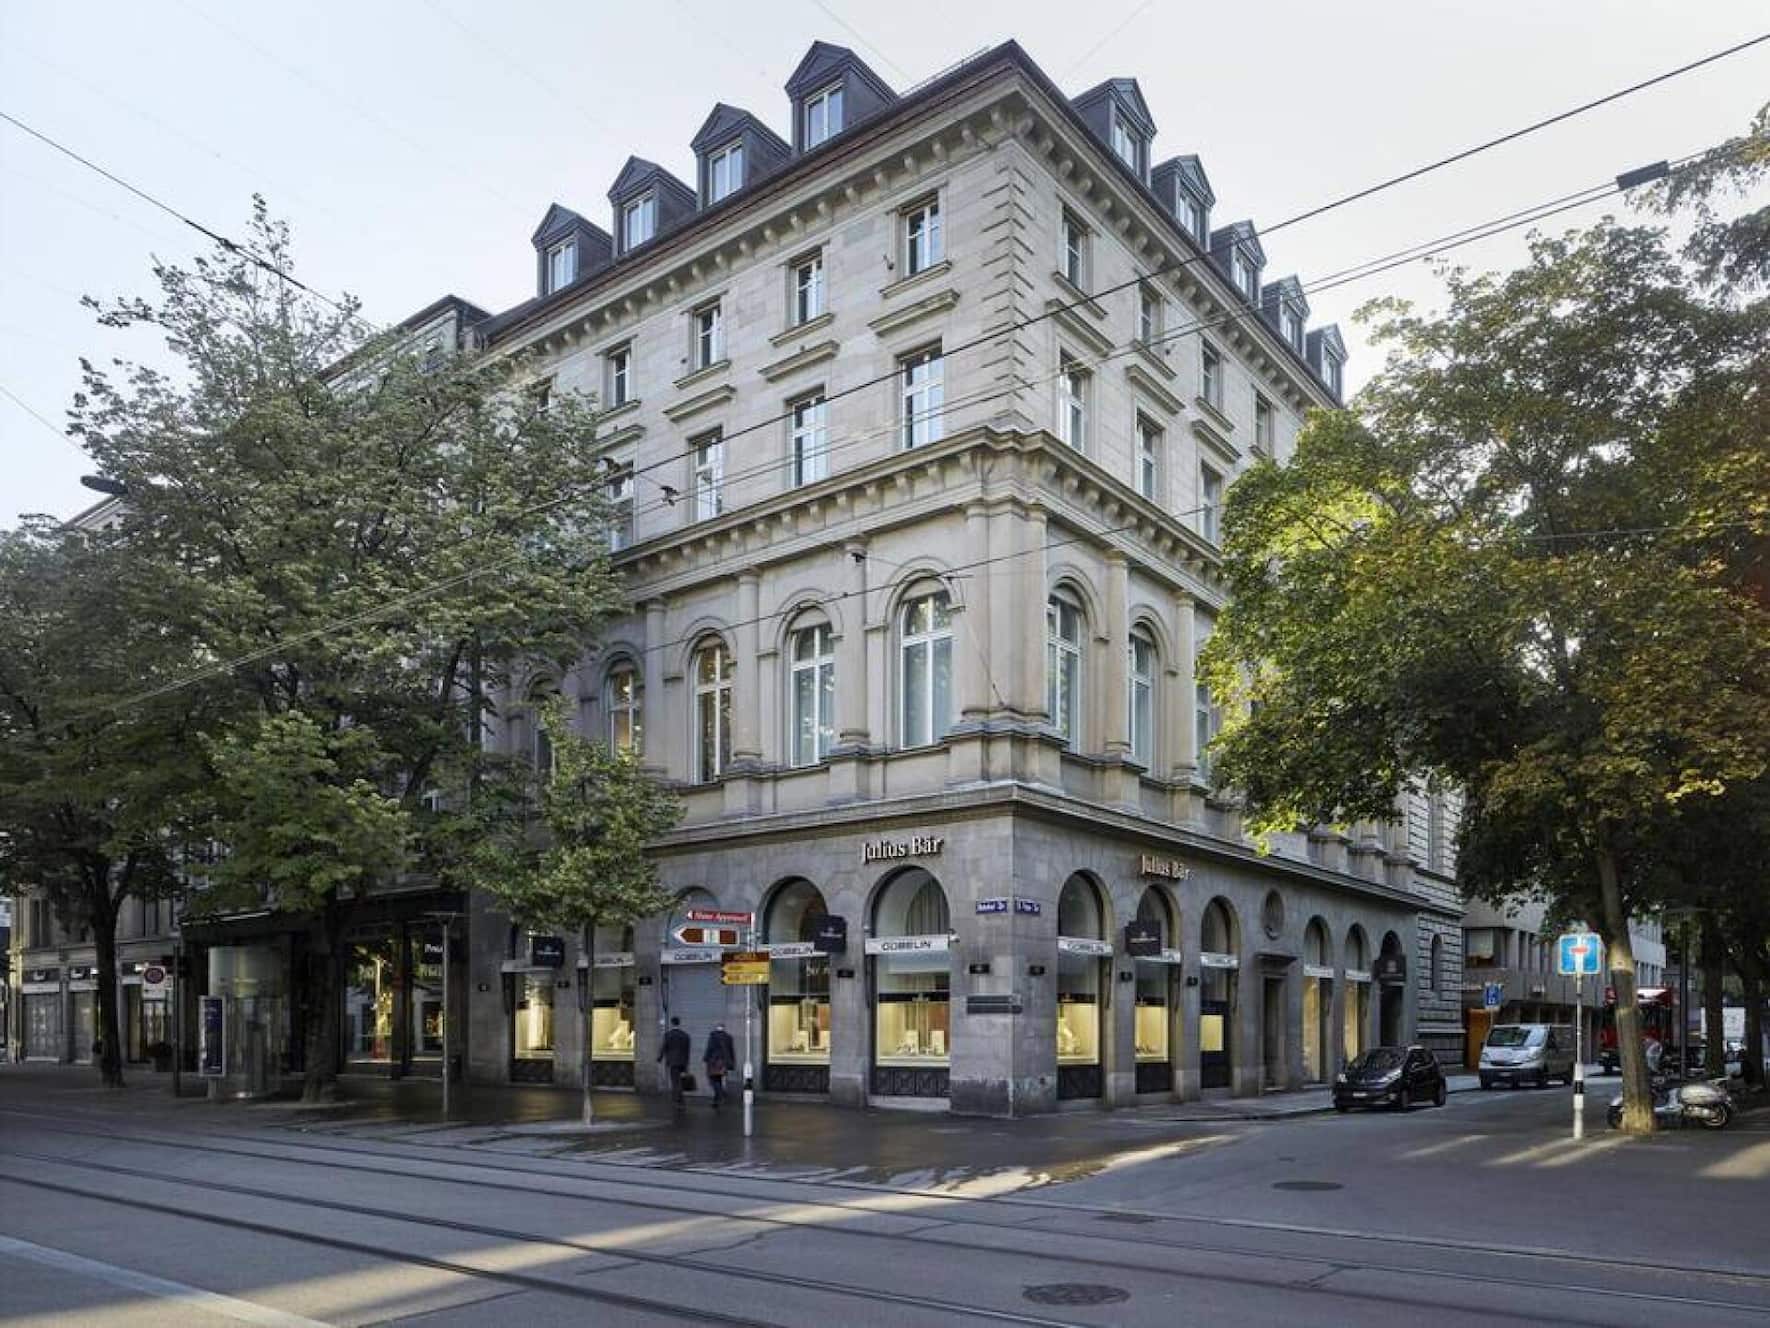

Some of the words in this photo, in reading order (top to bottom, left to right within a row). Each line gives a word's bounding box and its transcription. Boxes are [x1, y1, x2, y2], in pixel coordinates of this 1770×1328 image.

[862, 840, 907, 865] Julius
[912, 836, 944, 856] Bär
[1141, 853, 1172, 876] Julius
